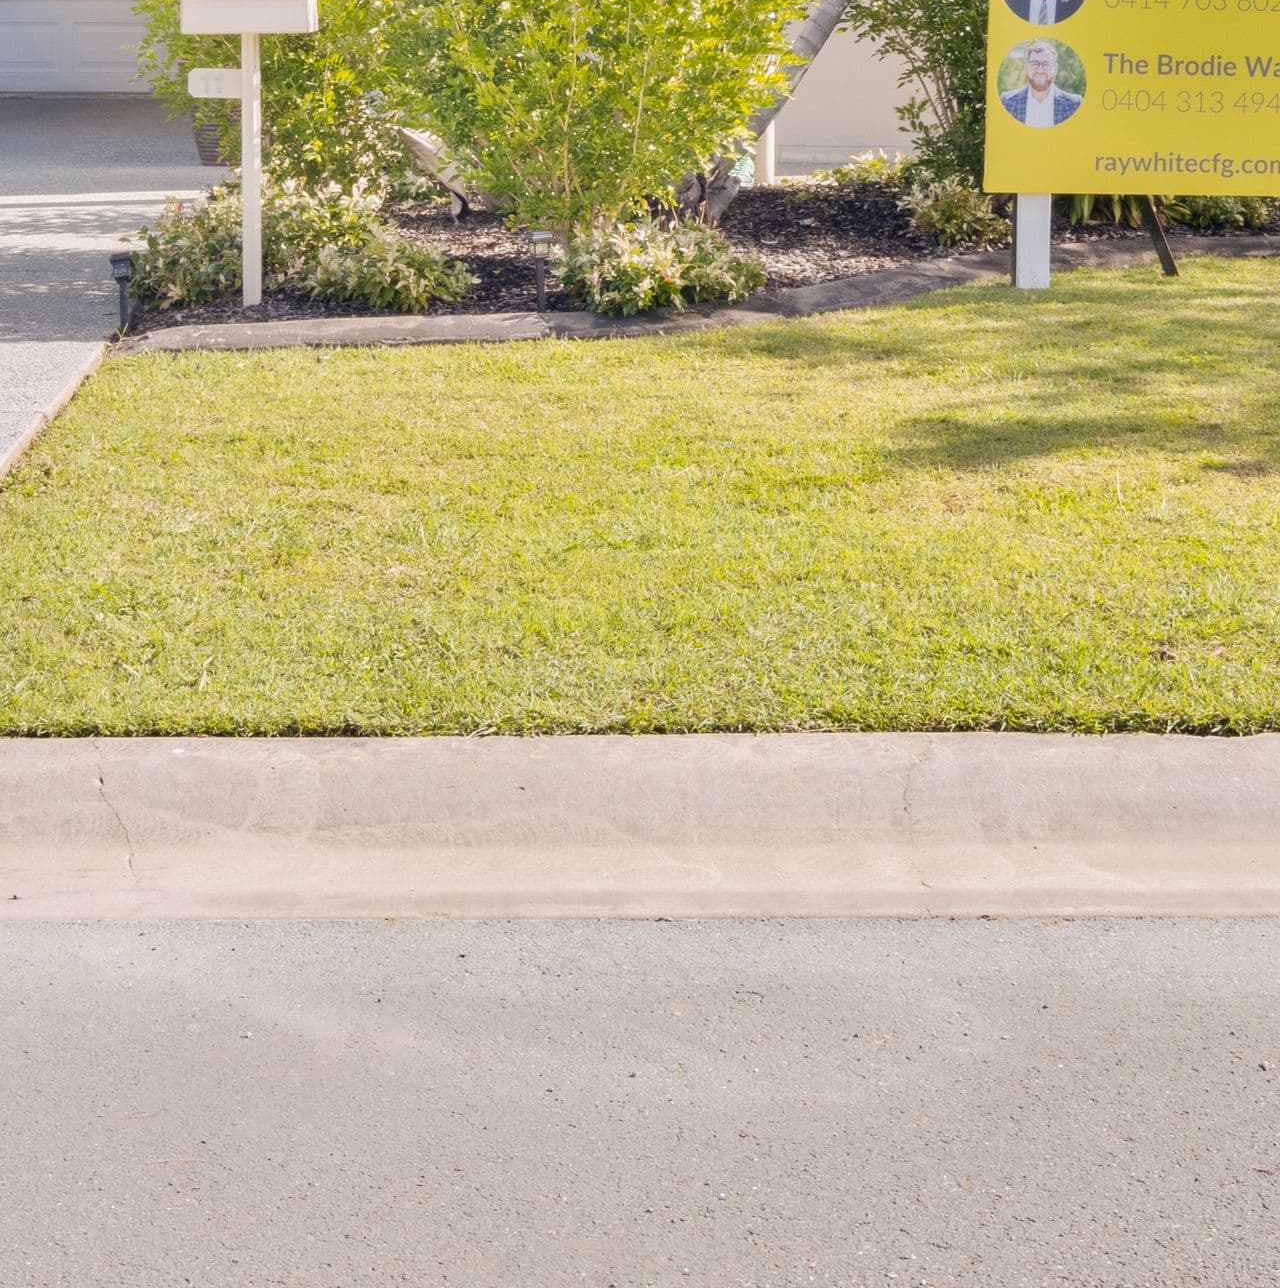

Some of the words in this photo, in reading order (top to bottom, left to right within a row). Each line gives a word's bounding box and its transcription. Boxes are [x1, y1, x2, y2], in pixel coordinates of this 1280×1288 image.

[1103, 53, 1148, 74] The
[1157, 54, 1237, 76] Brodie
[1102, 88, 1167, 111] 0404
[1177, 90, 1224, 113] 313
[1233, 92, 1280, 114] 494
